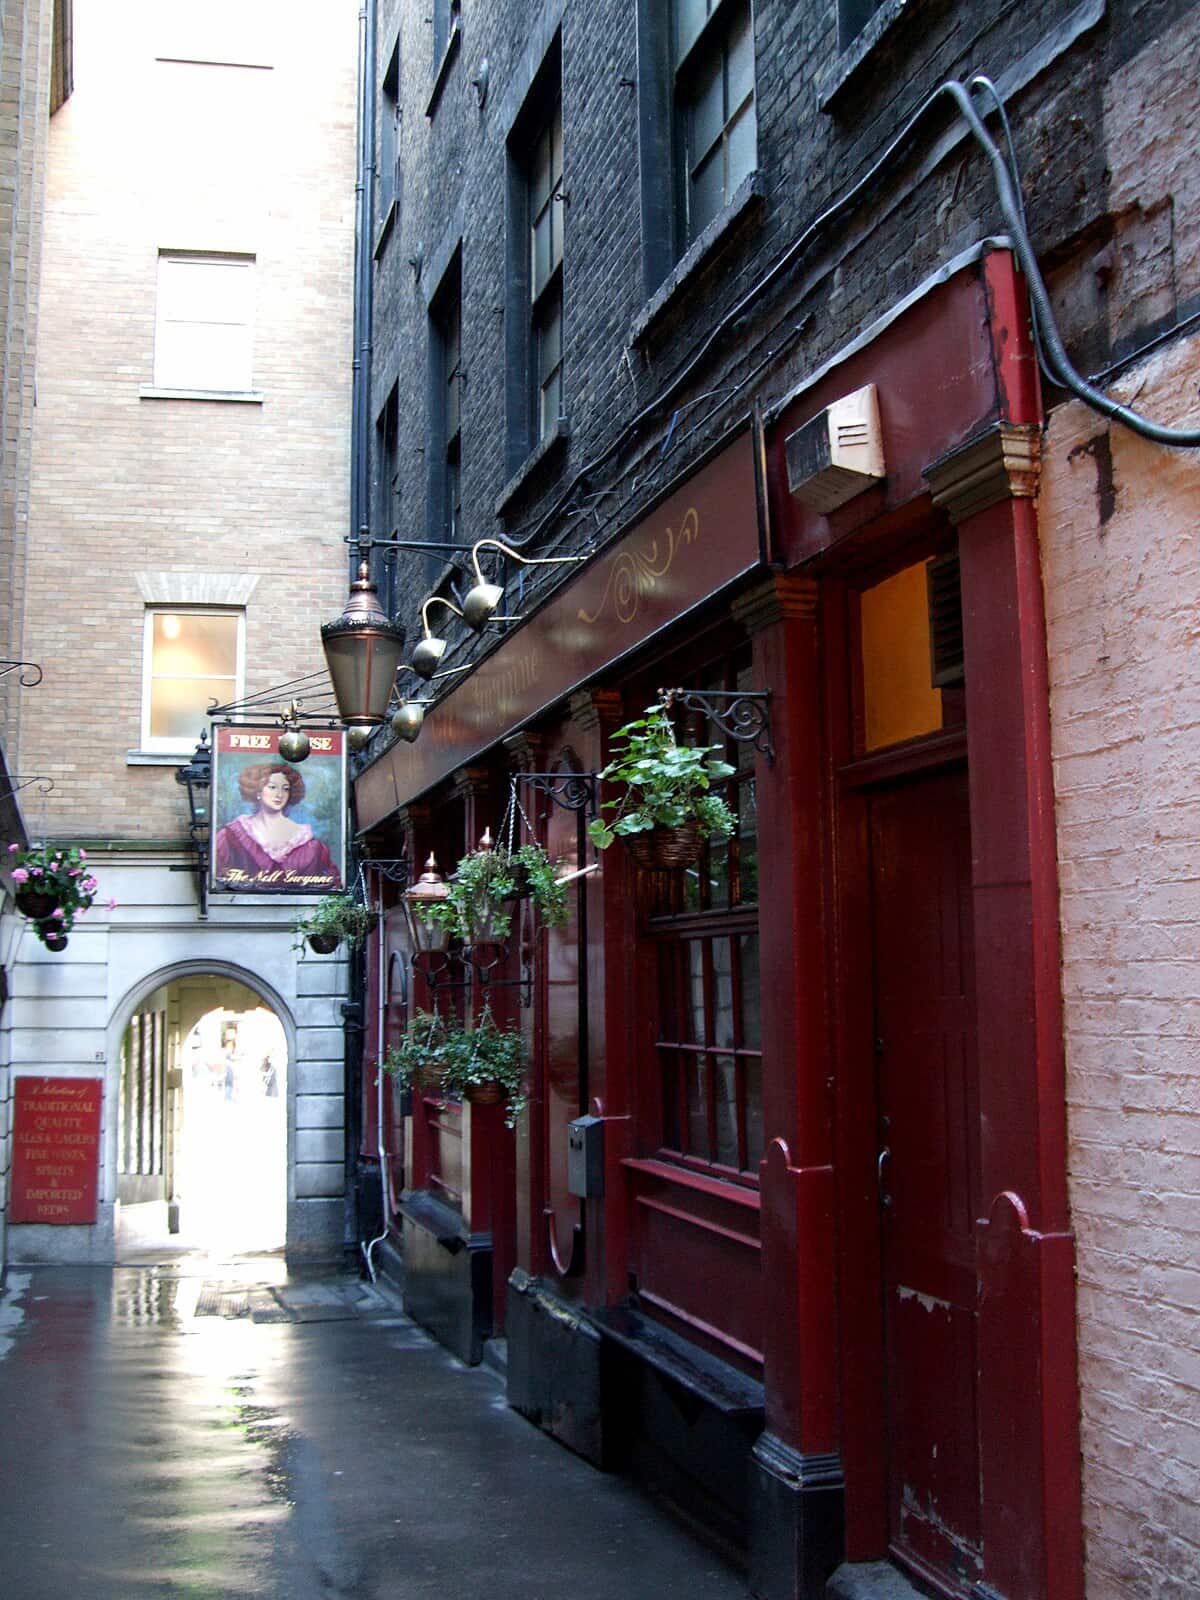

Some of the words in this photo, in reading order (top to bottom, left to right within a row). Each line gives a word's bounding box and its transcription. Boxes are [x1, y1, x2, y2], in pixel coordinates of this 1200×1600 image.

[229, 734, 271, 748] FREE
[224, 868, 248, 882] The
[249, 869, 283, 882] Nell
[284, 870, 333, 885] Gwynne
[22, 1101, 95, 1113] TRADITIONAL
[34, 1117, 81, 1129] QUALITY
[25, 1188, 83, 1201] IMPORTED
